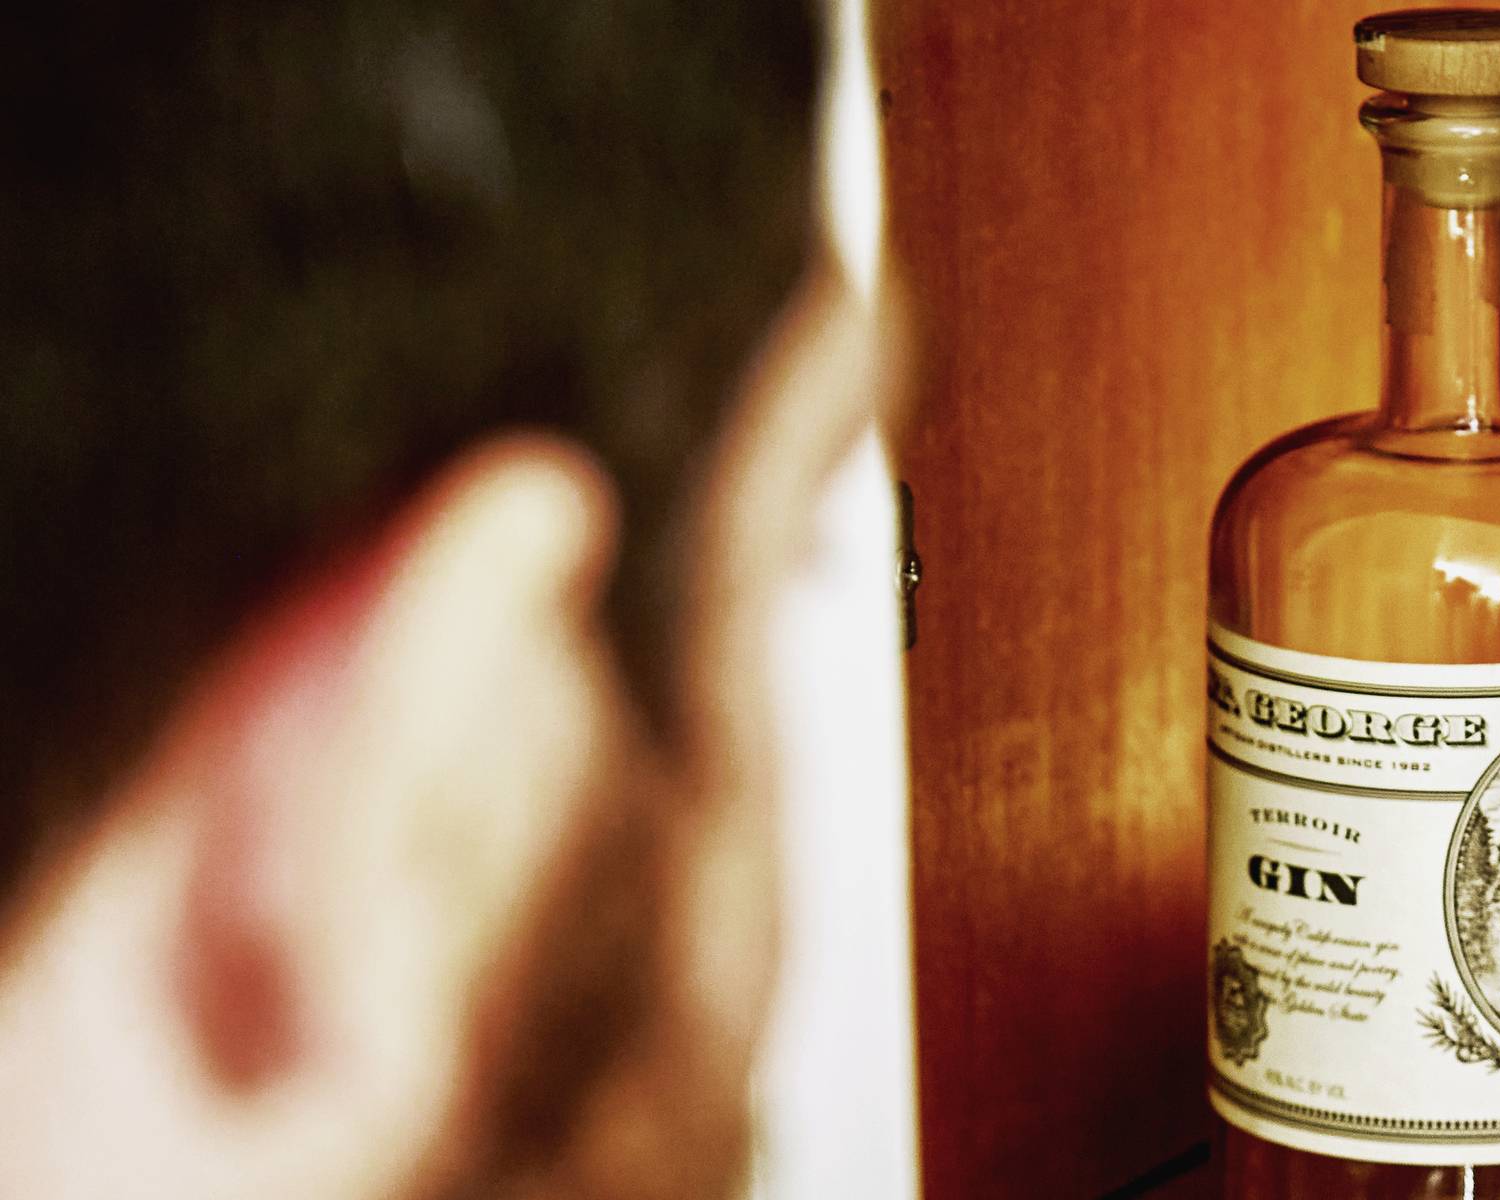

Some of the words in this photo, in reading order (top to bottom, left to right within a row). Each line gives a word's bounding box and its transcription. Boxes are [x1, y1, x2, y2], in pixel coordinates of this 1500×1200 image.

[1246, 688, 1487, 747] GEORGE
[1336, 755, 1383, 770] SINCE
[1391, 760, 1432, 772] 1982
[1250, 807, 1362, 844] TERROIR
[1247, 854, 1366, 907] GIN
